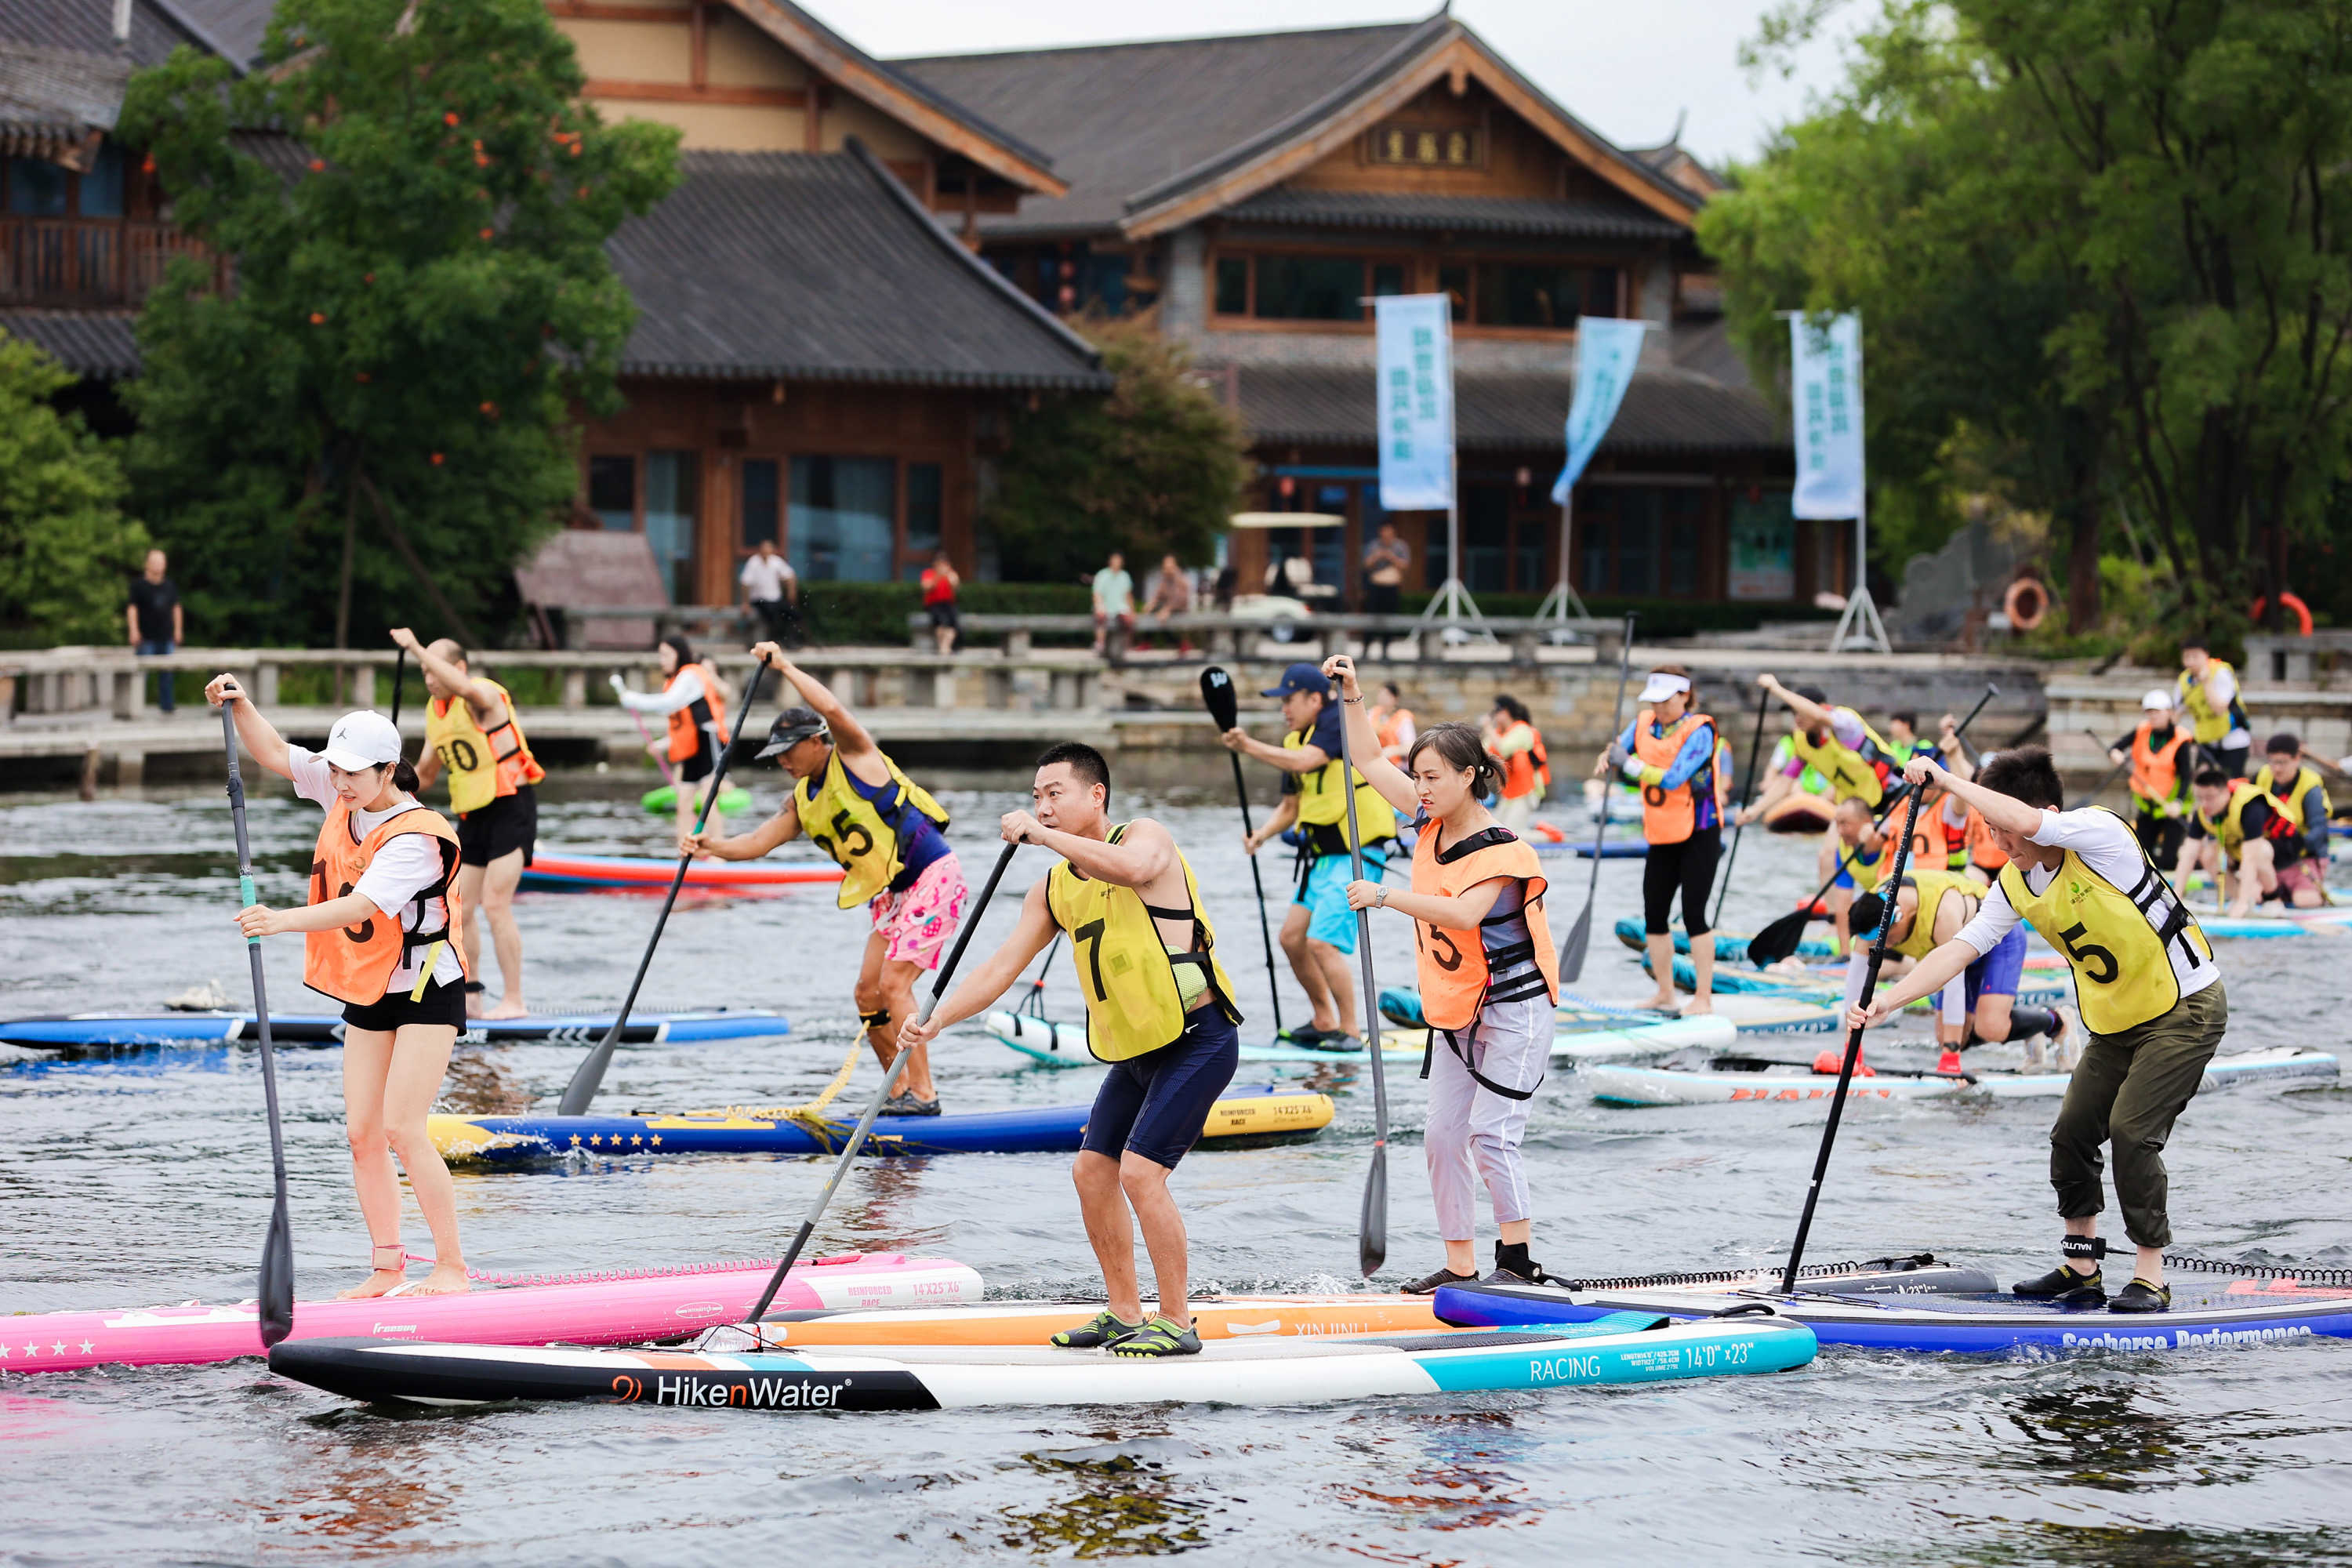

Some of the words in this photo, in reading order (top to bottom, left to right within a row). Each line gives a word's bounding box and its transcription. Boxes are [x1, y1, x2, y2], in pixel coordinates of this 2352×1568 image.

[812, 808, 873, 871] 25
[1075, 917, 1107, 1002] 7
[2058, 922, 2118, 984] 5
[848, 1286, 893, 1296] REINFORCED
[1530, 1355, 1601, 1382] RACING
